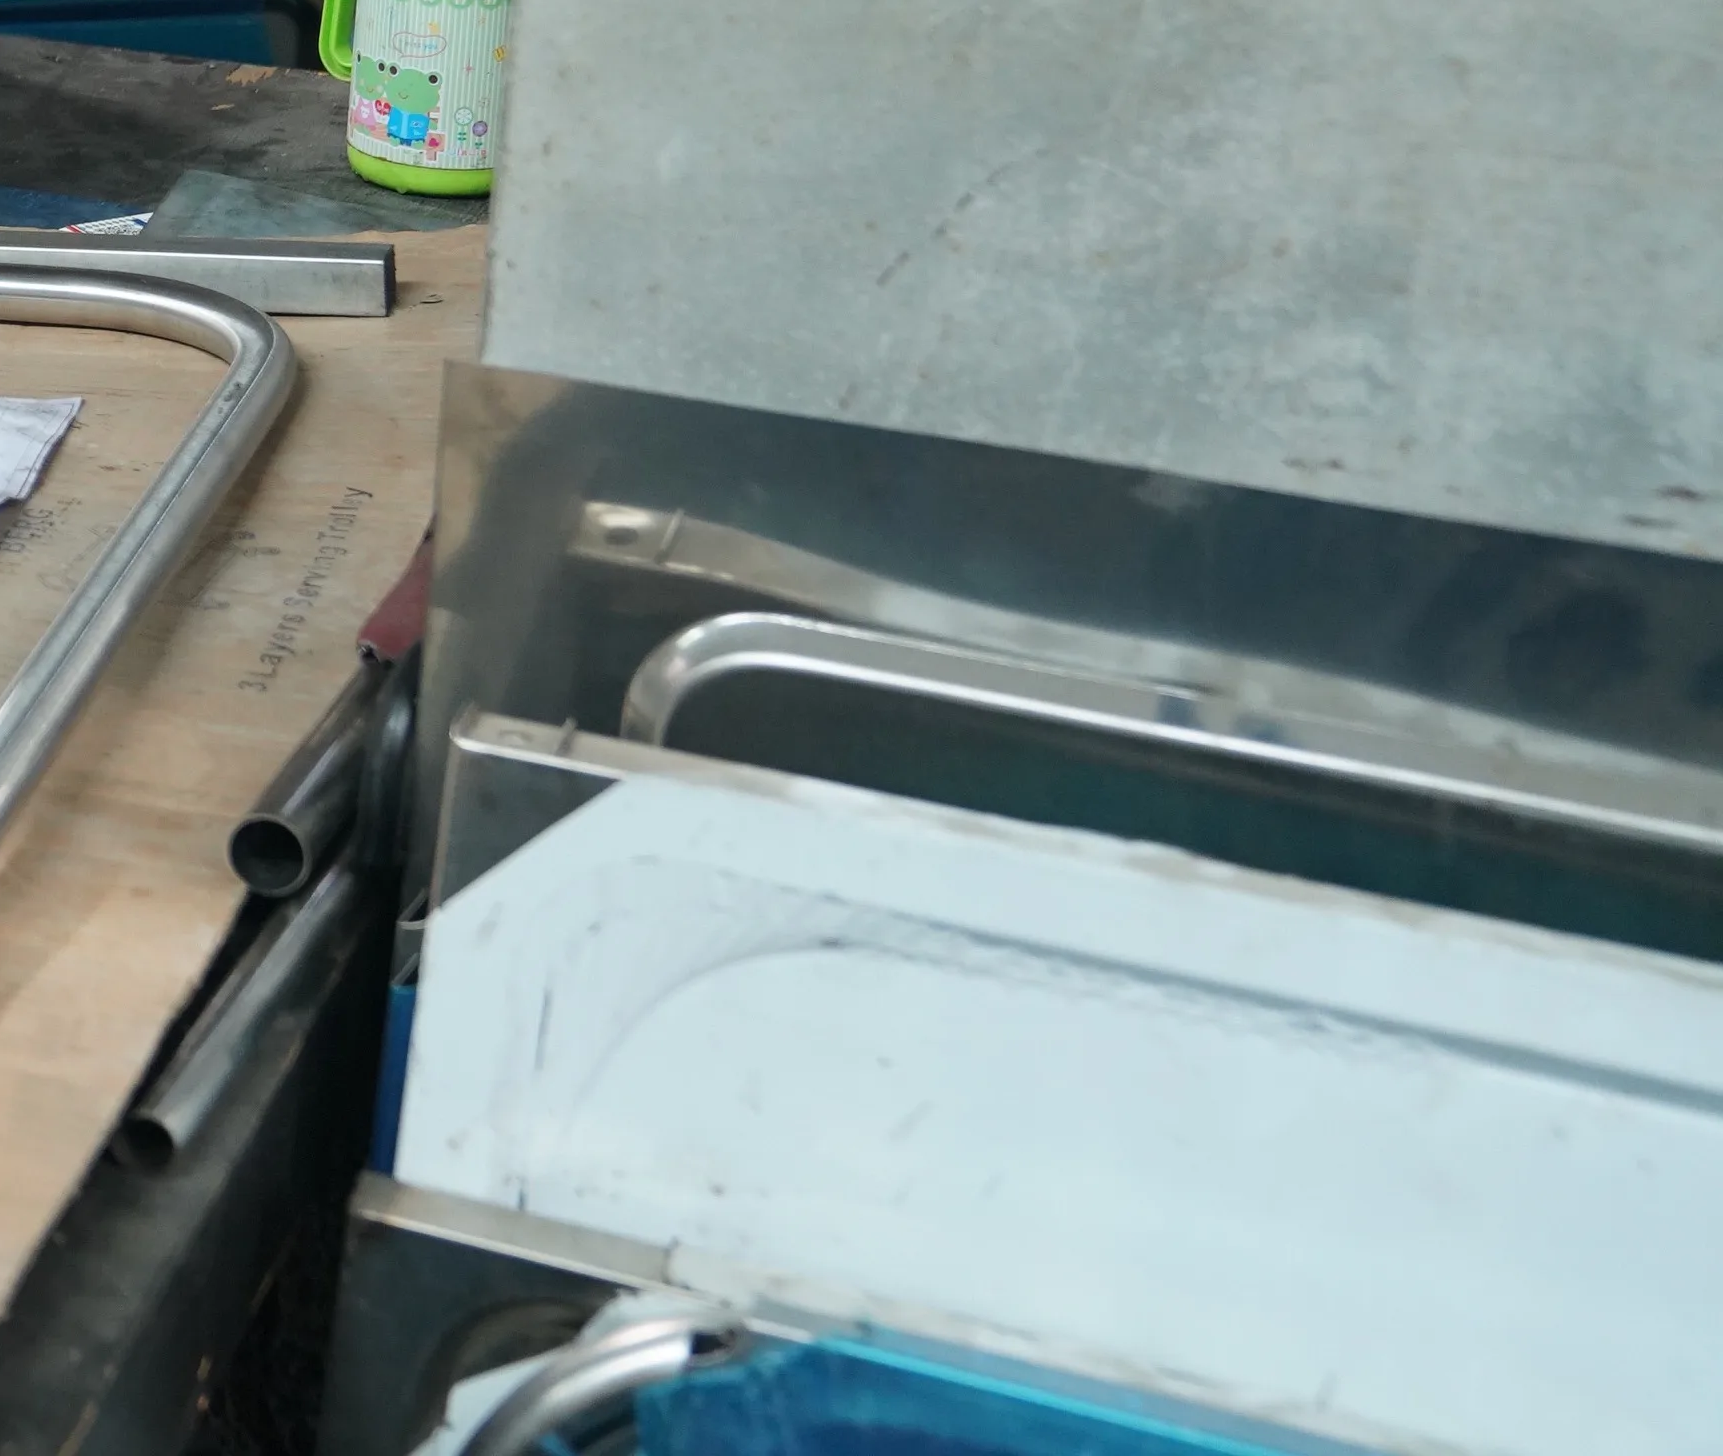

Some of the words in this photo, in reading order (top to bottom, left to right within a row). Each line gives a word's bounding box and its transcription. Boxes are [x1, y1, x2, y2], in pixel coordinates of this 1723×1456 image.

[250, 614, 305, 679] Layers
[283, 545, 348, 608] Serving
[316, 486, 373, 540] Trolley
